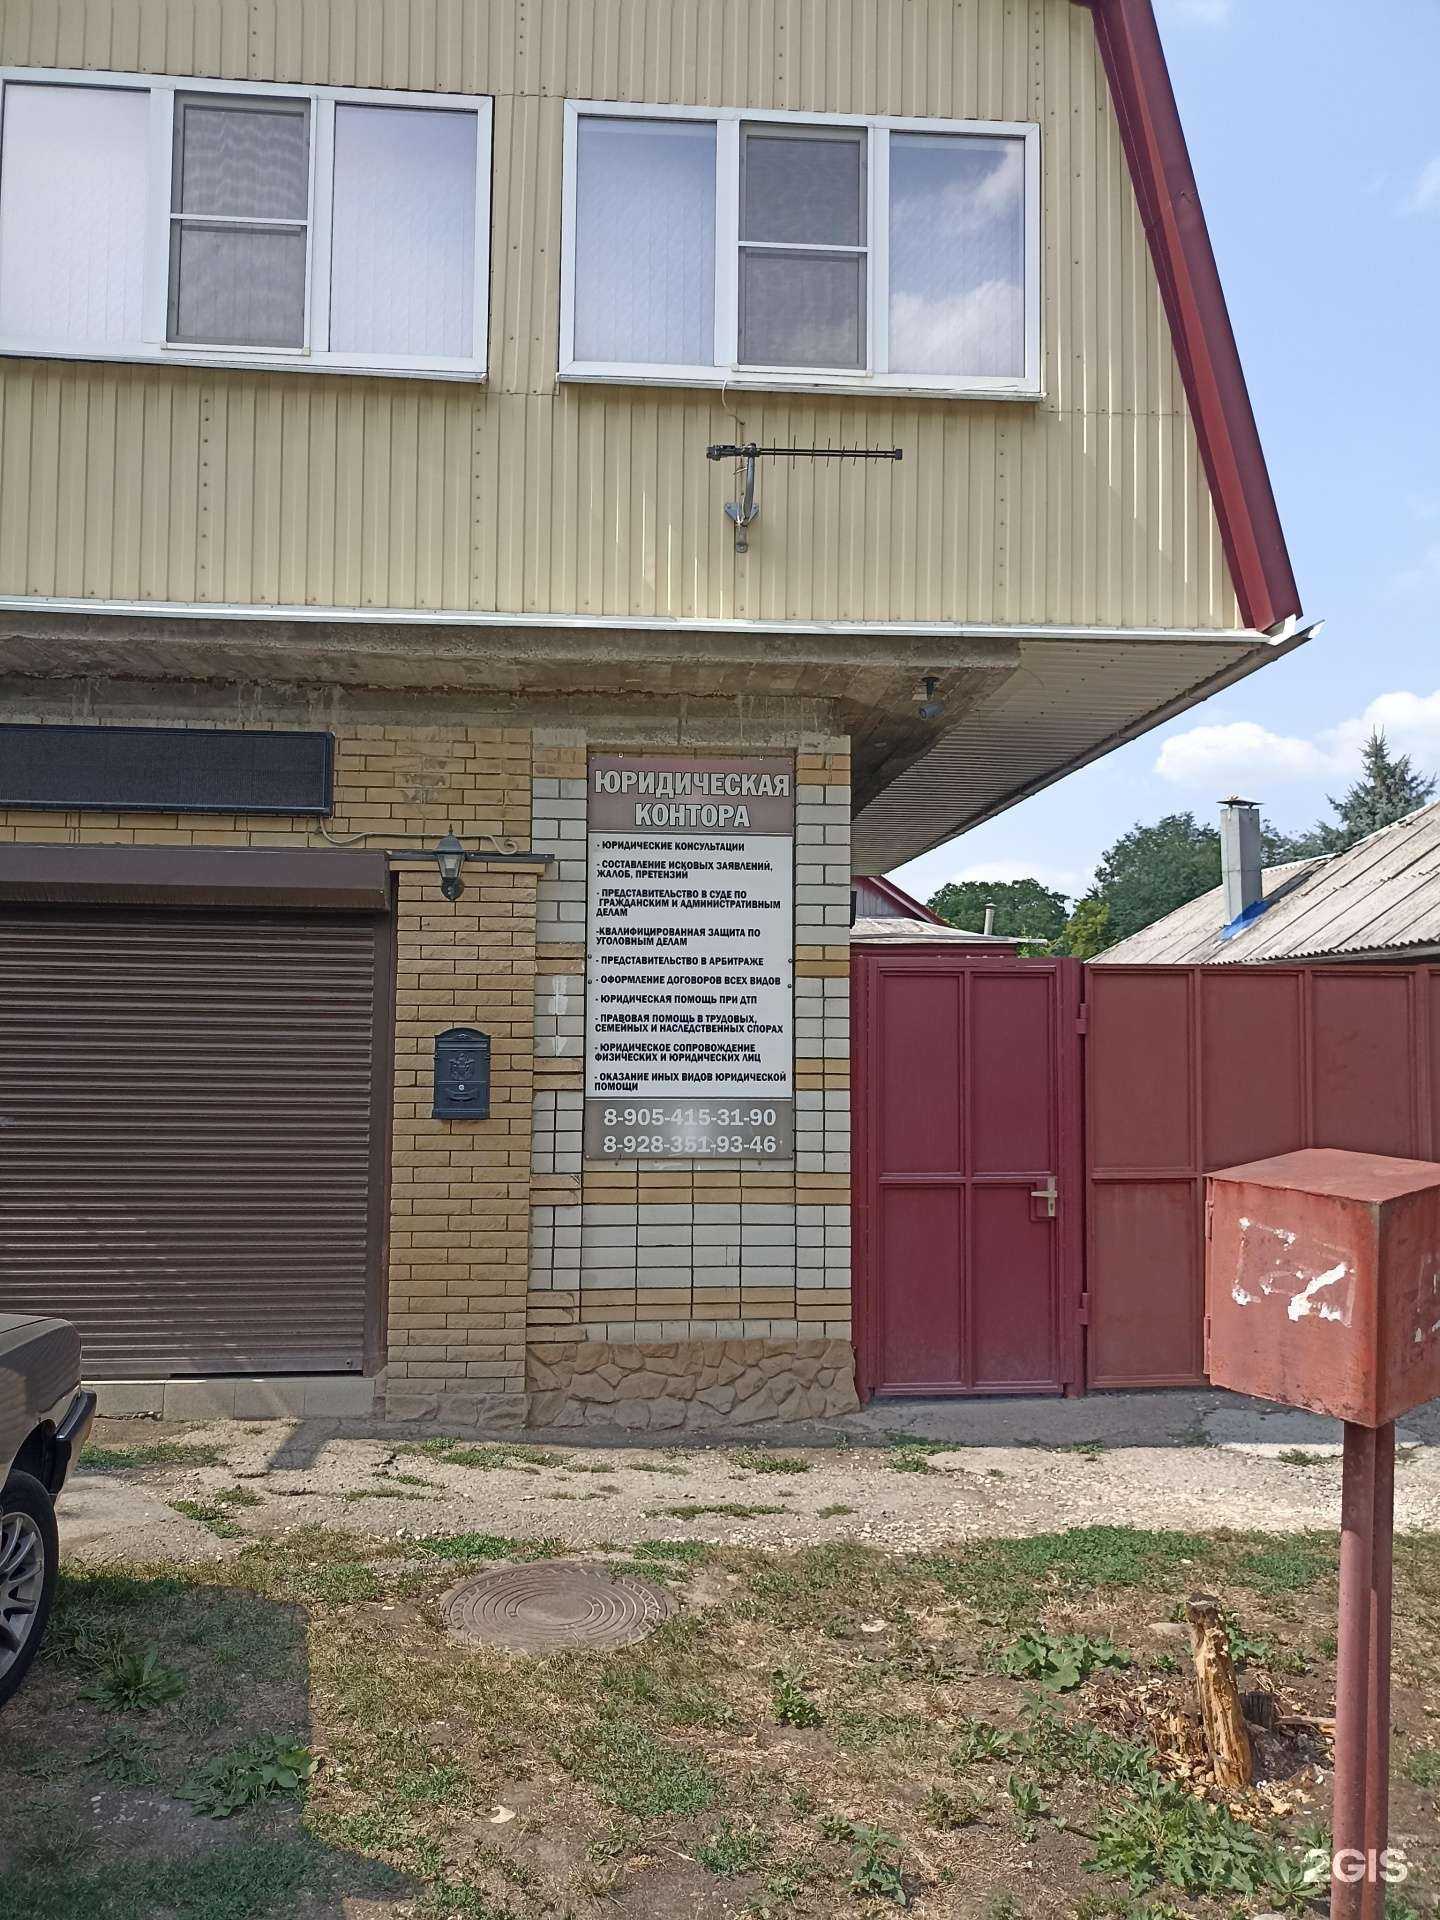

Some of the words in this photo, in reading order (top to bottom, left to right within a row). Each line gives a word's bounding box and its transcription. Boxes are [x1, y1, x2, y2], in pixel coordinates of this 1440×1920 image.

[595, 771, 790, 798] ЮРИДИЧЕСКАЯ
[635, 804, 750, 827] КОНТОРА
[602, 841, 672, 851] ЮРИДИЧЕСКИЕ
[674, 843, 744, 852] КОНСУЛЬТАЦИИ
[602, 860, 666, 870] СОСТАВЛЕНИЕ
[668, 861, 713, 870] ИСКОВЫХ
[601, 889, 699, 898] ПРЕДСТАВИТЕЛЬСТВО
[709, 891, 732, 899] СУДЕ
[599, 899, 669, 907] ГРАЖДАНСКИМ
[680, 900, 780, 909] АДМИНИСТРАТИВНЫМ
[596, 908, 627, 917] ДЕЛАМ
[708, 928, 745, 938] ЗАЩИТА
[748, 929, 760, 937] ПО
[596, 937, 654, 945] УГОЛОВНЫМ
[656, 938, 687, 946] ДЕЛАМ
[601, 956, 699, 966] ПРЕДСТАВИТЕЛЬСТВО
[709, 957, 764, 966] АРБИТРАЖЕ
[600, 975, 665, 984] ОФОРМЛЕНИЕ
[667, 976, 722, 986] ДОГОВОРОВ
[724, 977, 748, 985] ВСЕХ
[750, 977, 781, 986] ВИДОВ
[600, 995, 672, 1004] ЮРИДИЧЕСКАЯ
[674, 995, 717, 1005] ПОМОЩЬ
[719, 996, 738, 1004] ПРИ
[740, 996, 757, 1005] ДТП
[600, 1014, 649, 1023] ПРАВОВАЯ
[652, 1014, 695, 1024] ПОМОЩЬ
[697, 1015, 703, 1023] В
[595, 1023, 649, 1033] СЕМЕЙНЫХ
[651, 1024, 658, 1032] И
[660, 1024, 745, 1033] НАСЛЕДСТВЕННЫХ
[747, 1025, 783, 1033] СПОРАХ
[600, 1043, 671, 1052] ЮРИДИЧЕСКОЕ
[673, 1044, 755, 1053] СОПРОВОЖДЕНИЕ
[595, 1052, 658, 1062] ФИЗИЧЕСКИХ
[669, 1053, 740, 1062] ЮРИДИЧЕСКИХ
[742, 1054, 761, 1063] ЛИЦ
[599, 1072, 649, 1081] ОКАЗАНИЕ
[651, 1073, 679, 1081] ИНЫХ
[682, 1073, 713, 1082] ВИДОВ
[715, 1071, 786, 1083] ЮРИДИЧЕСКОЙ
[595, 1082, 638, 1092] ПОМОЩИ
[603, 1108, 776, 1126] 8-905-415-31-90
[603, 1136, 776, 1153] 8-928-351-93-46
